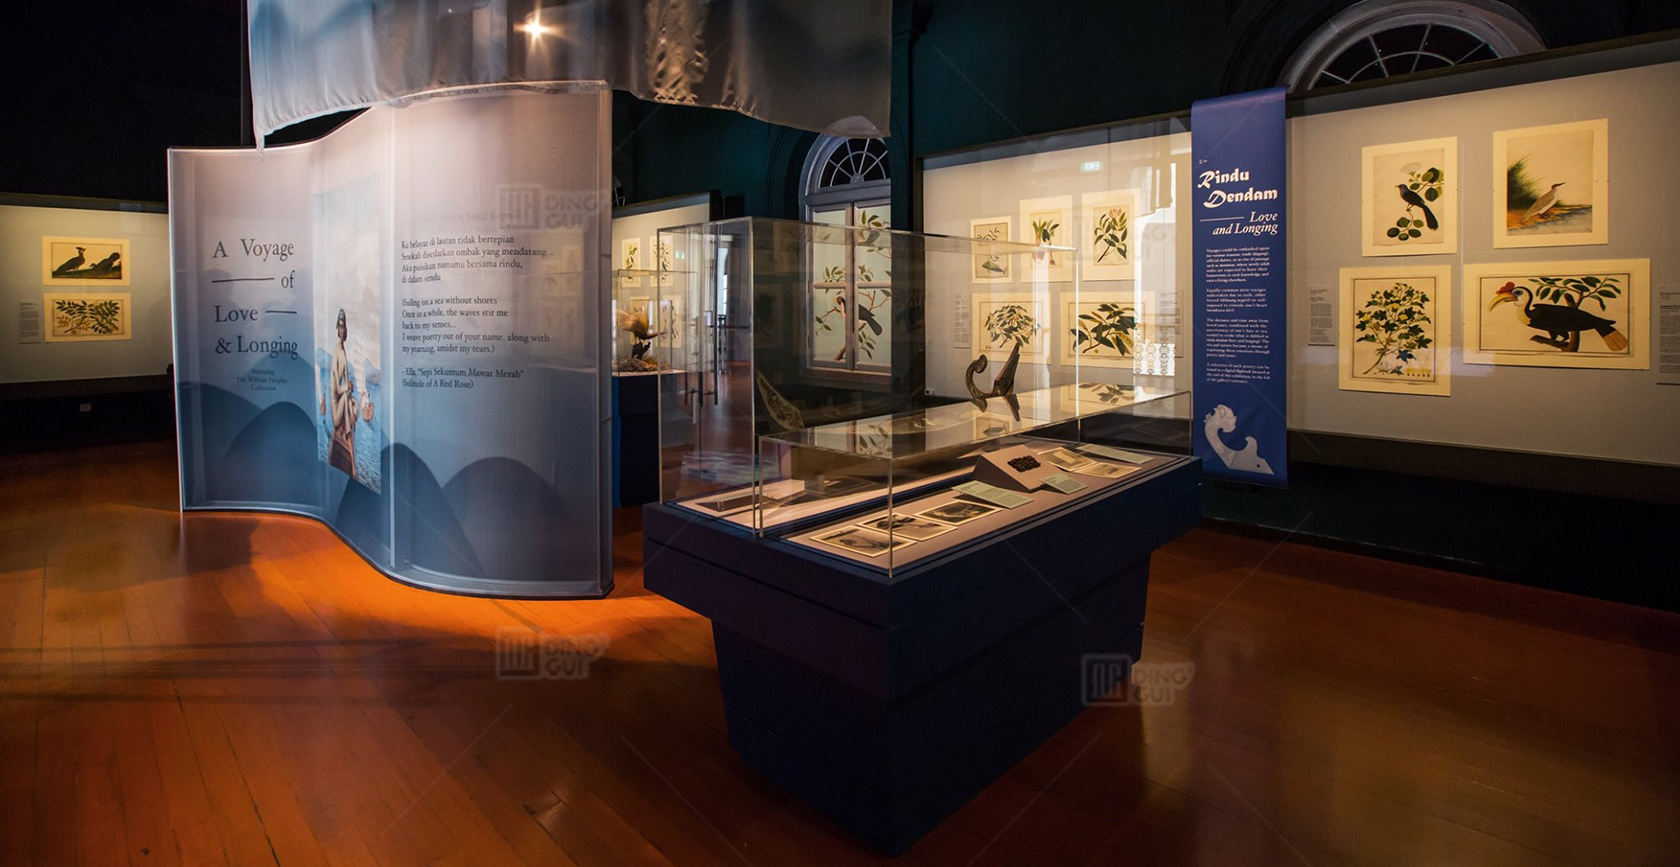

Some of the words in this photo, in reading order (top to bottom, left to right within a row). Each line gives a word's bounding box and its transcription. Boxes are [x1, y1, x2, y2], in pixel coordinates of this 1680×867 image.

[1197, 168, 1249, 189] Rindu
[1203, 187, 1278, 208] Dendam
[1250, 211, 1278, 222] Love
[1212, 223, 1233, 235] and
[1234, 222, 1278, 236] Longing
[437, 237, 456, 245] lautan
[478, 236, 514, 246] bertepian
[212, 241, 228, 258] A
[240, 238, 294, 262] Voyage
[499, 260, 523, 269] rindu,
[281, 270, 295, 288] of
[424, 274, 440, 282] sendu
[214, 305, 258, 322] Love
[423, 334, 441, 342] poetry
[507, 334, 529, 344] along
[531, 334, 550, 342] with
[215, 338, 232, 354] &
[236, 335, 298, 360] Longing
[434, 368, 467, 376] Sekuntum
[468, 369, 492, 377] Mawar
[495, 370, 524, 378] Merah"
